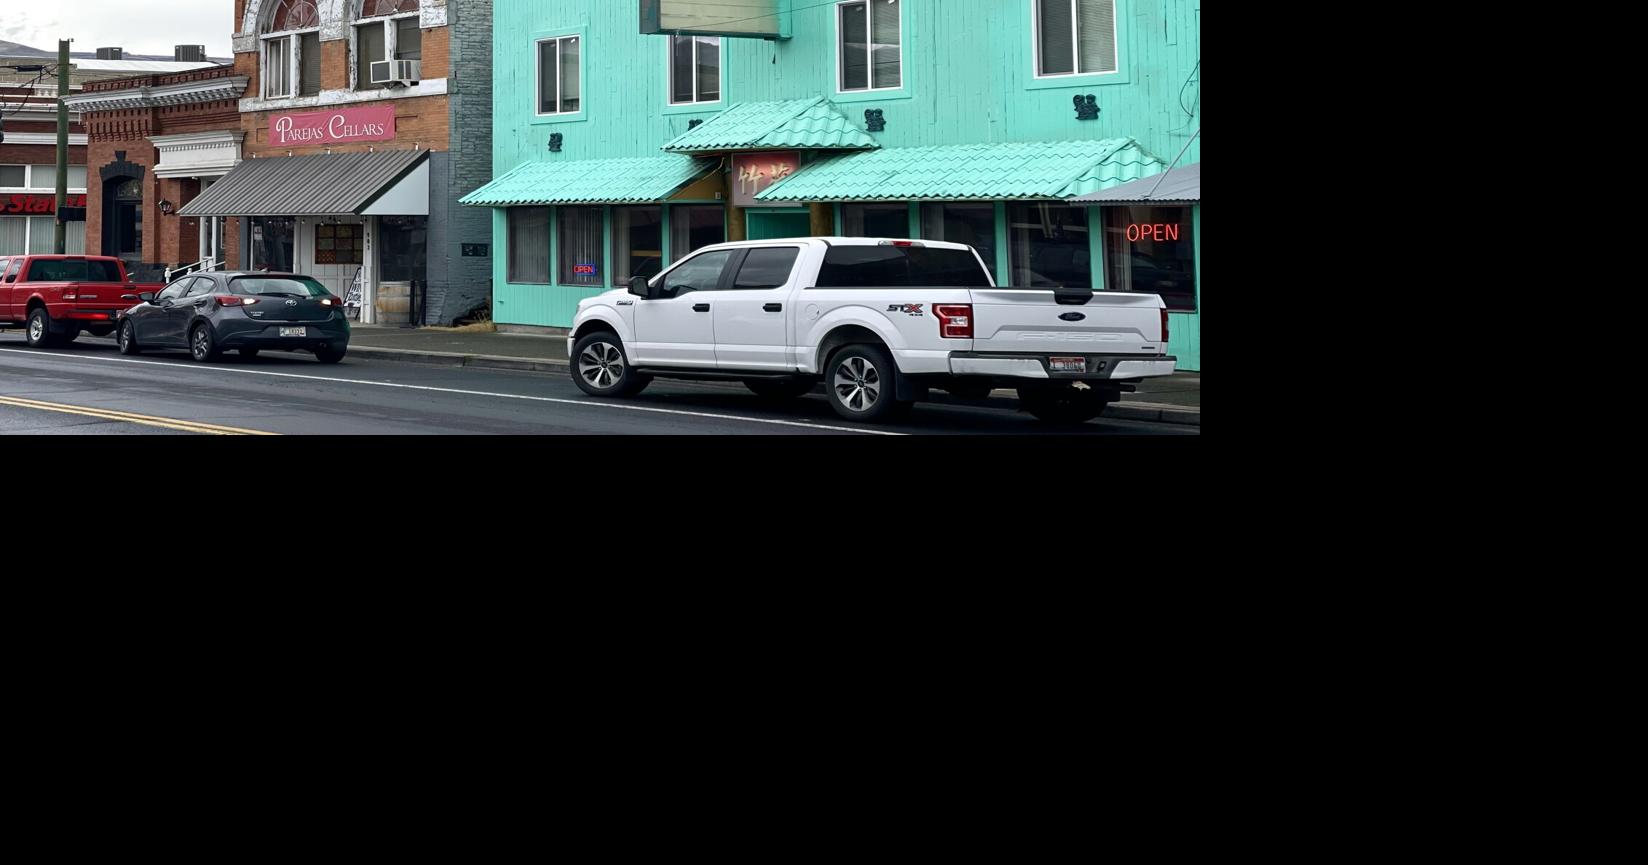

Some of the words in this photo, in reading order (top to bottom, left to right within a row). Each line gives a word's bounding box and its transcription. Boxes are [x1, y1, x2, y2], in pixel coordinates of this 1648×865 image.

[276, 116, 323, 143] PAREJAS
[329, 115, 384, 139] CELLARS
[1126, 223, 1178, 241] OPEN
[574, 265, 594, 273] OPEN
[886, 303, 923, 313] STX
